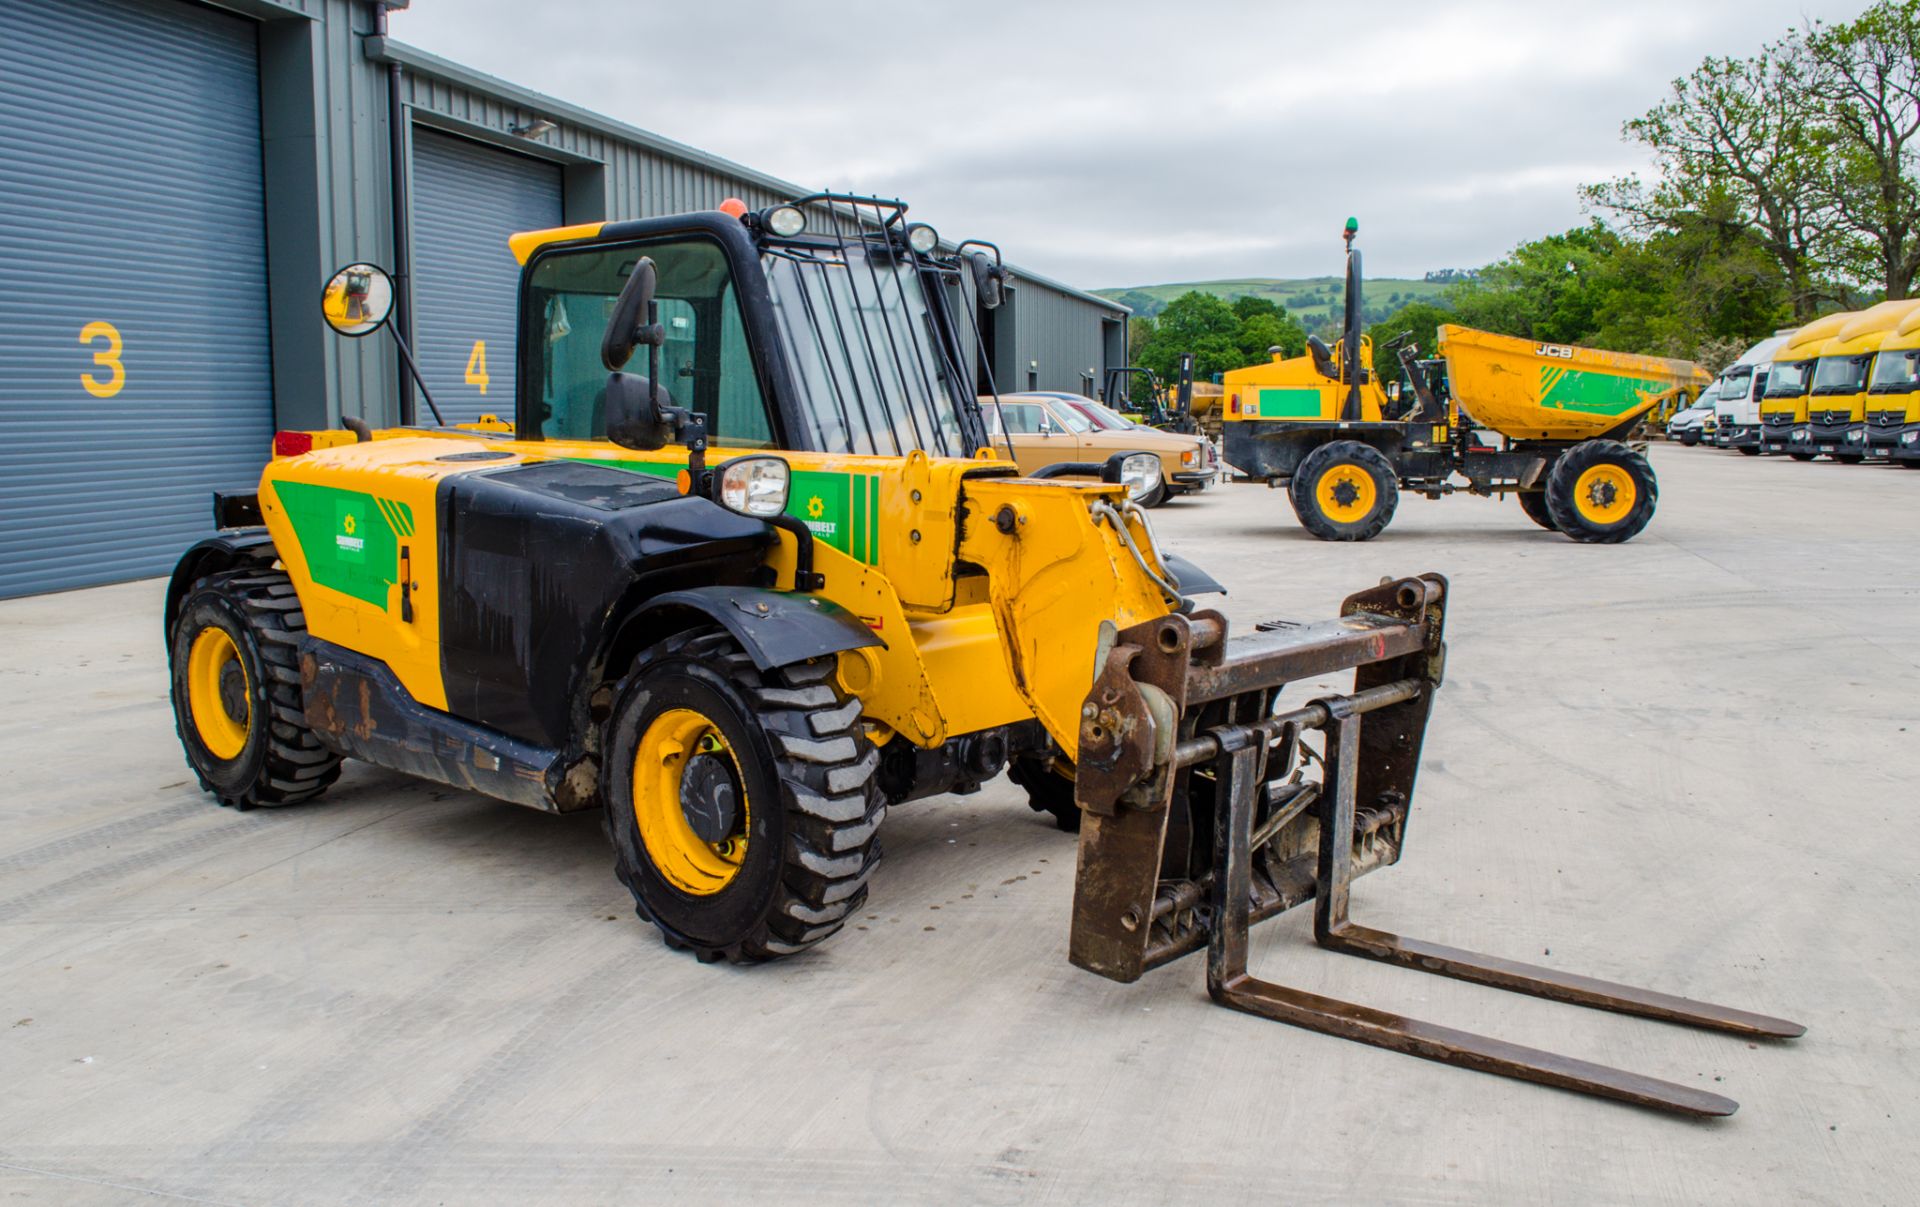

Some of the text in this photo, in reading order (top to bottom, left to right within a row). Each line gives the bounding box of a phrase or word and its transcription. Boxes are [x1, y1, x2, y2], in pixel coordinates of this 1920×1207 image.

[79, 321, 126, 398] 3
[464, 339, 490, 395] 4
[1536, 344, 1572, 359] JCB
